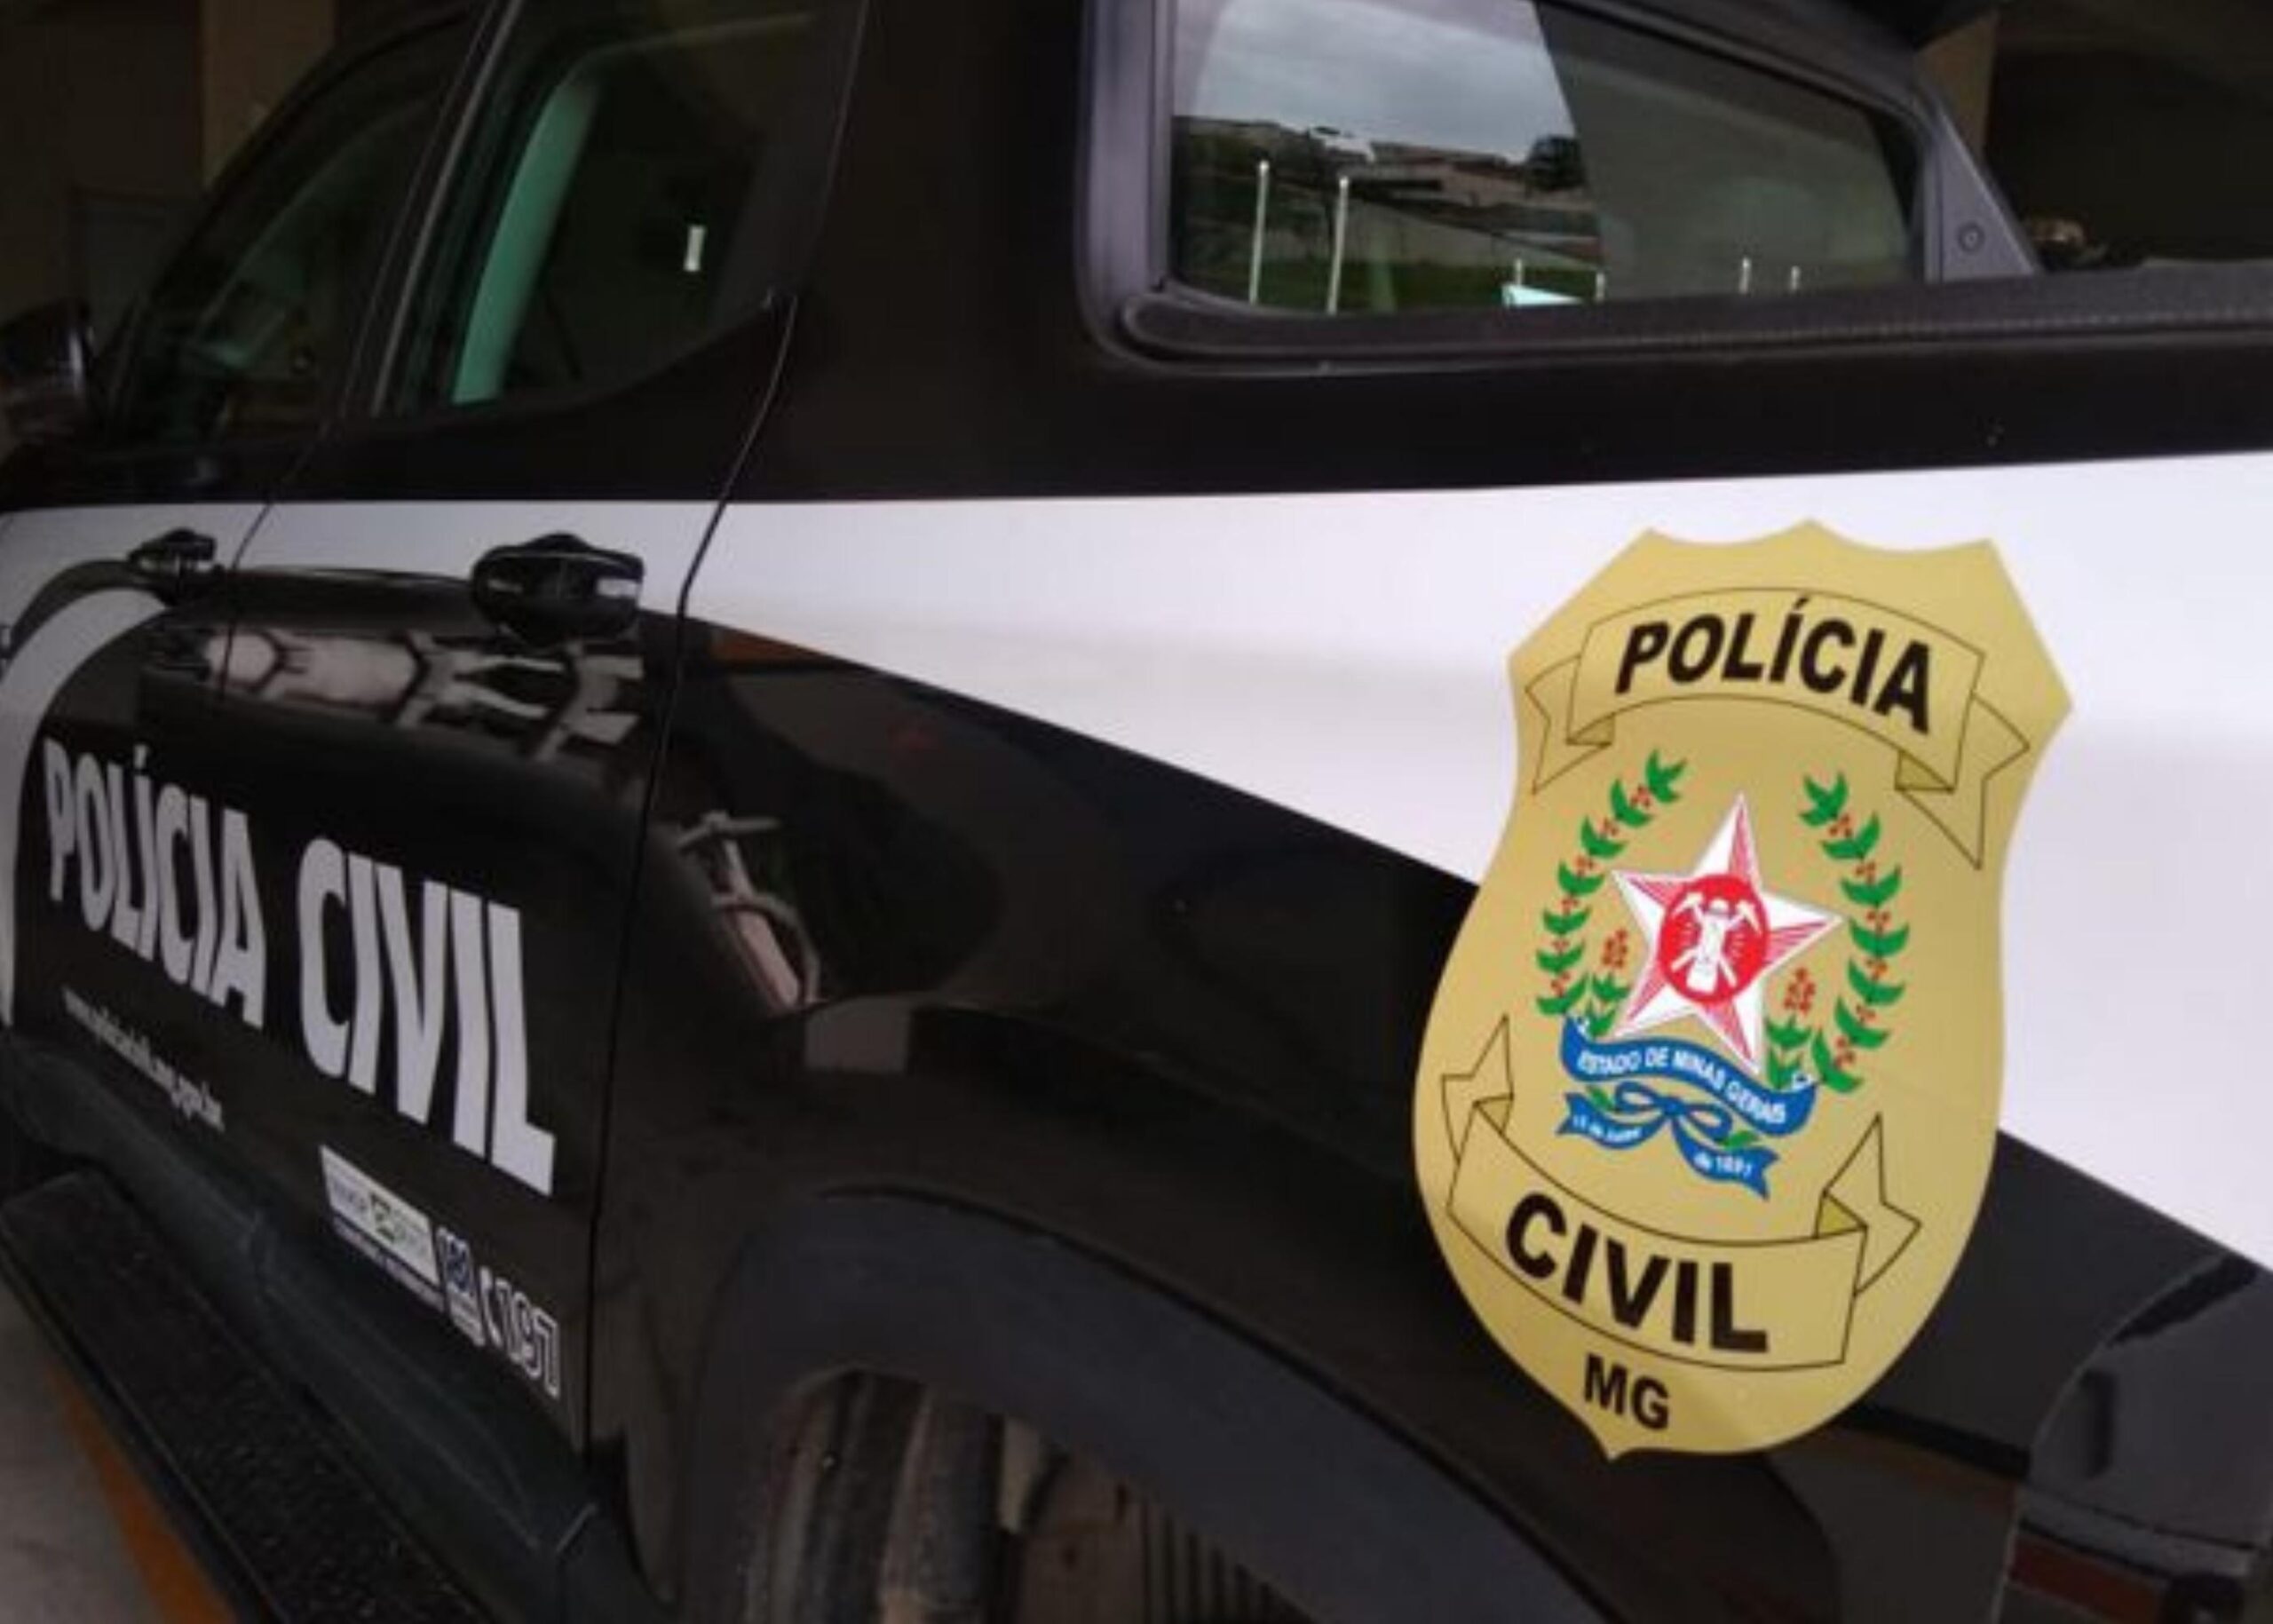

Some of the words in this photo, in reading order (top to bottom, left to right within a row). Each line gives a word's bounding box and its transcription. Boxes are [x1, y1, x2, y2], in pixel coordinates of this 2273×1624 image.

[1613, 595, 1931, 735] POLÍCIA
[43, 738, 266, 1031] POLÍCIA
[297, 837, 556, 1196] CIVIL
[1576, 1050, 1642, 1075] ESTADO
[1644, 1046, 1670, 1067] DE
[1672, 1050, 1726, 1091] MINAS
[1726, 1081, 1786, 1125] GERAIS
[1505, 1191, 1770, 1354] CIVIL
[1583, 1353, 1670, 1430] MG
